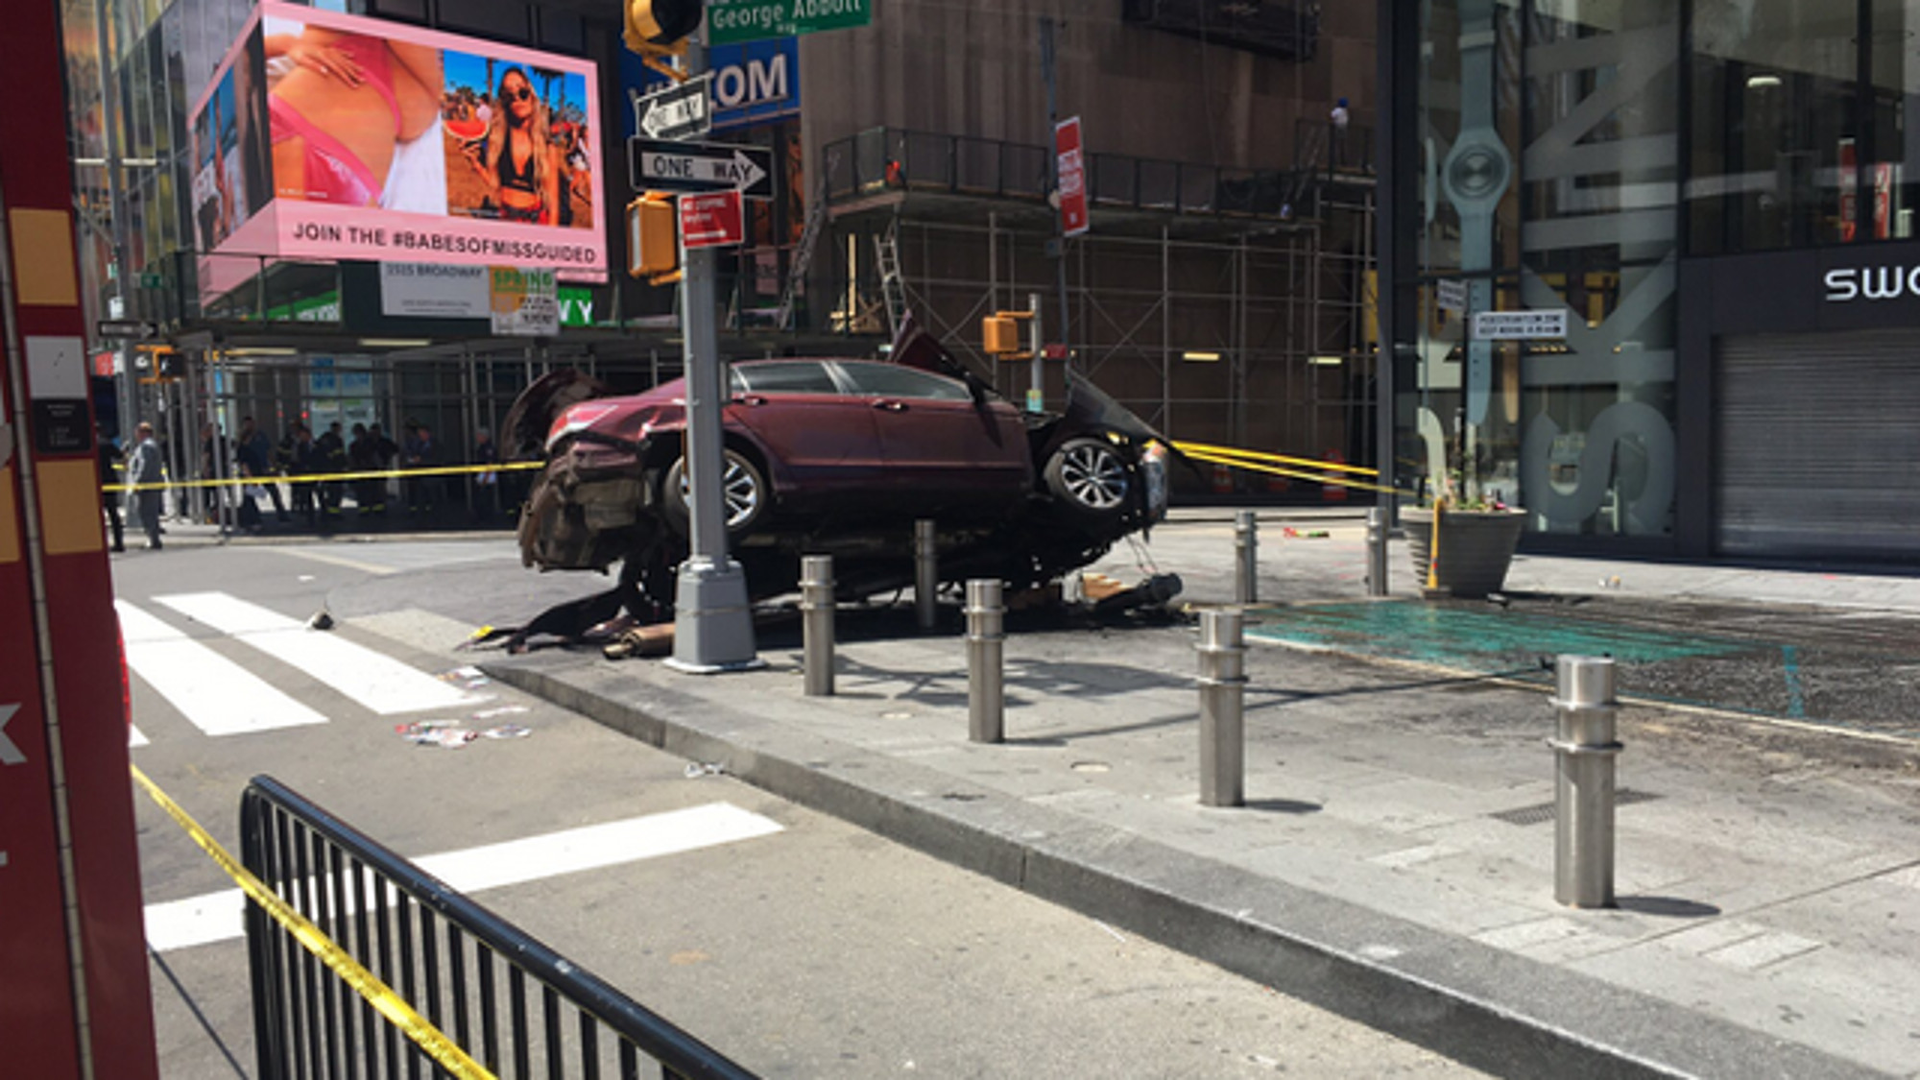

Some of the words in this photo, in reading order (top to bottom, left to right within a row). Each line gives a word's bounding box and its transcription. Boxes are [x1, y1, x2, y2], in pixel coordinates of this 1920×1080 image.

[713, 4, 784, 30] George
[792, 0, 861, 19] Abbott
[653, 155, 693, 178] ONE
[711, 161, 754, 181] WAY
[293, 222, 341, 242] JOIN
[348, 226, 387, 247] THE
[393, 230, 597, 263] #BABESOFMISSGUIDED
[416, 264, 483, 278] BROADWAY
[494, 269, 553, 286] SPRING
